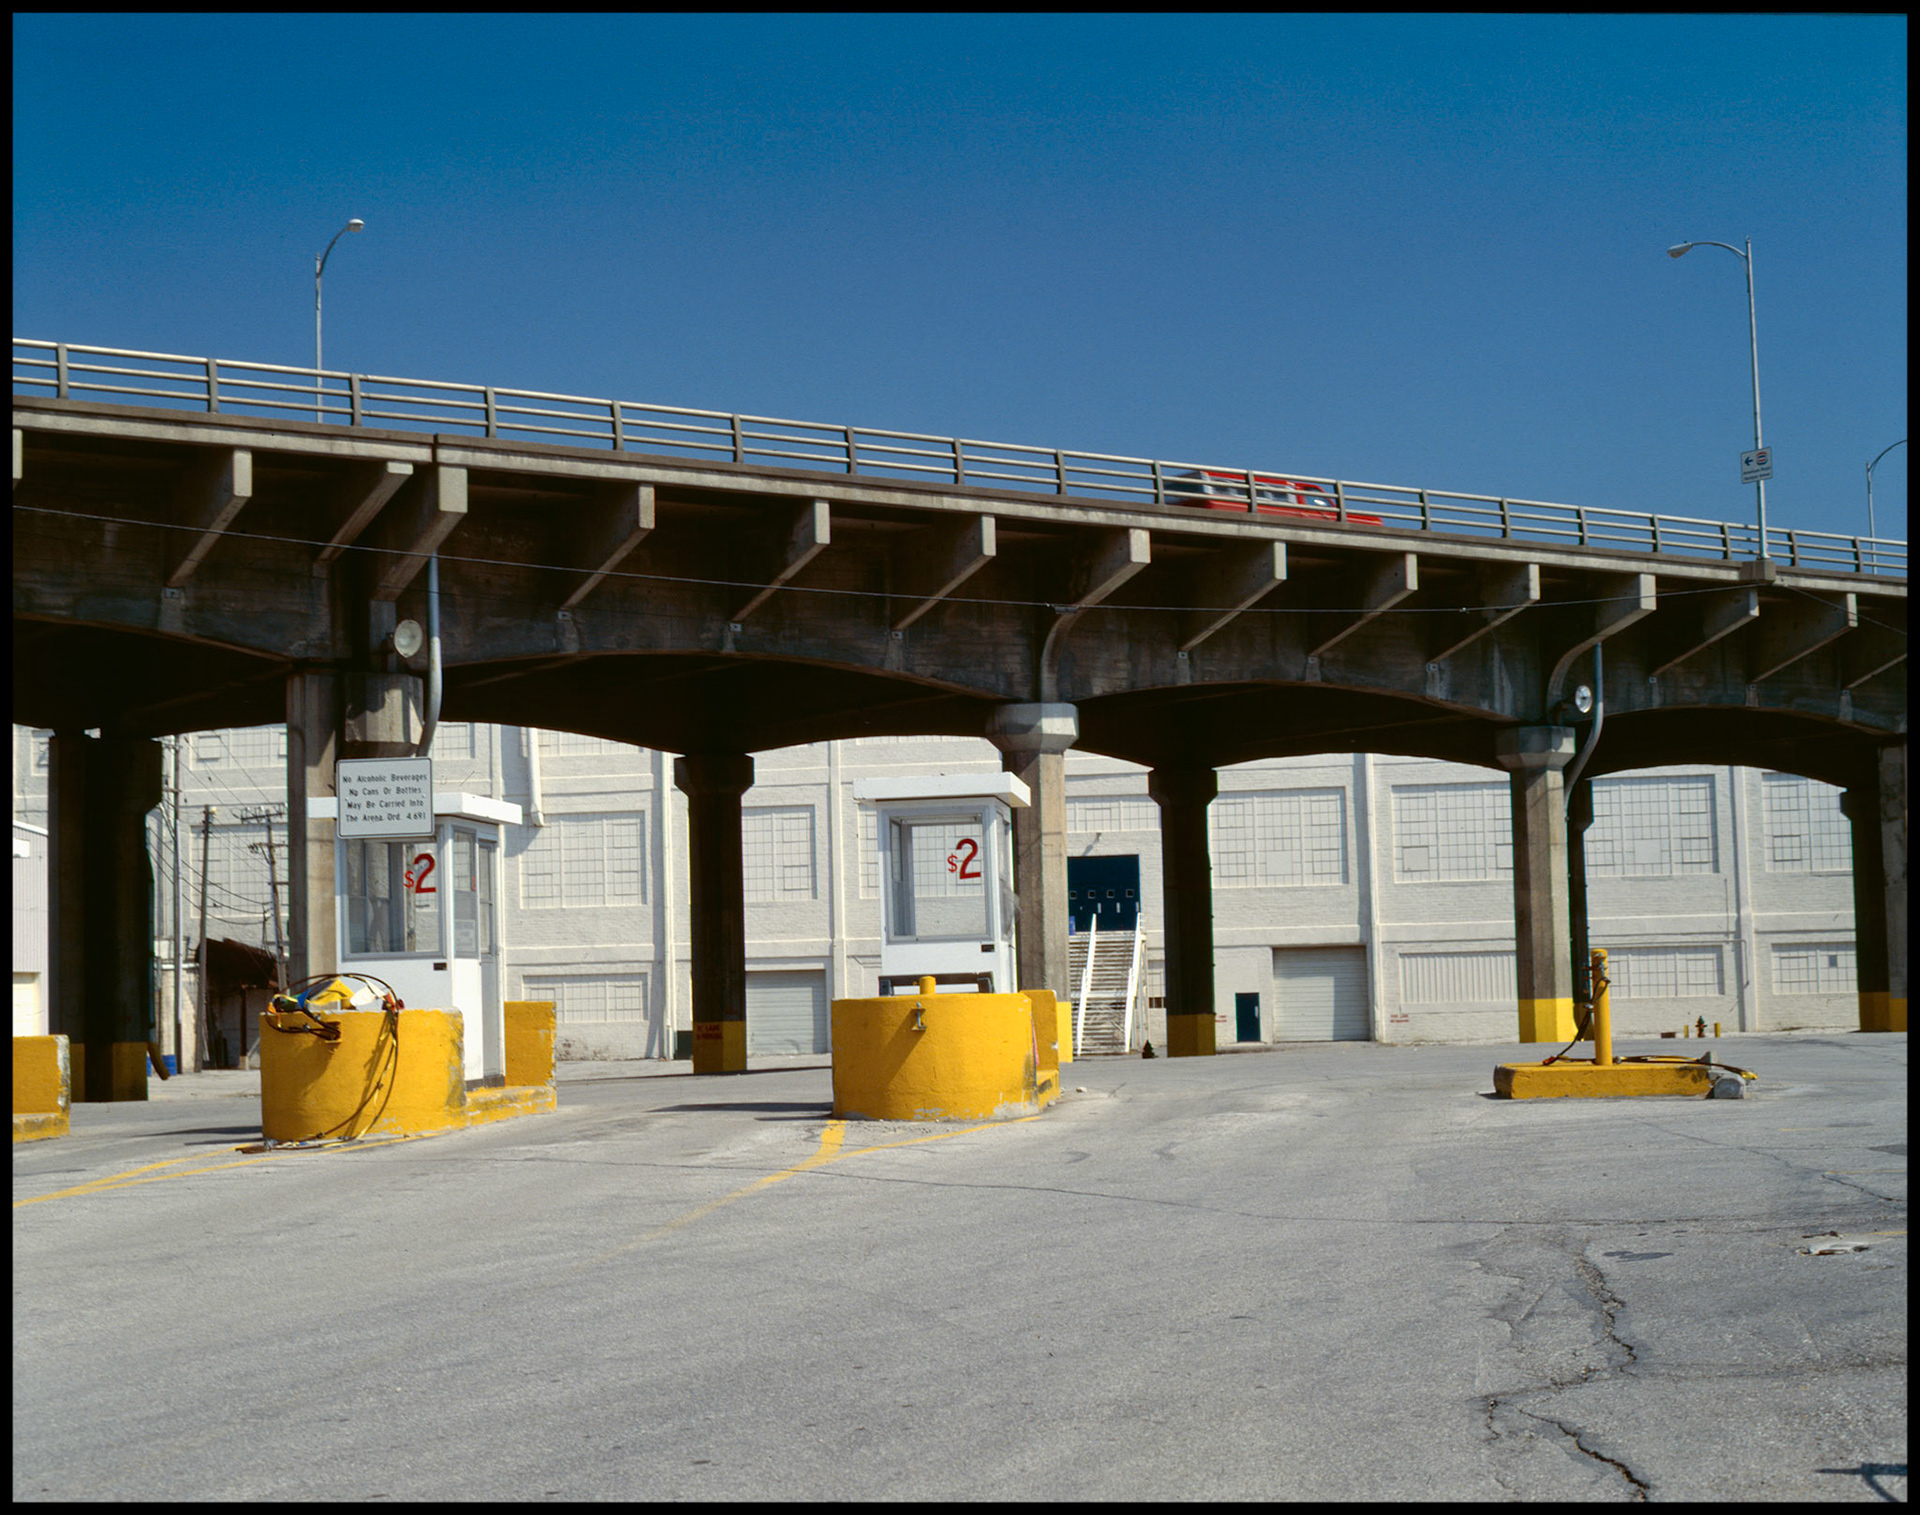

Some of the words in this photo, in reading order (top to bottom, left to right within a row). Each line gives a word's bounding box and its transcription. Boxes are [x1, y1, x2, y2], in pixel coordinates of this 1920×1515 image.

[357, 775, 387, 783] Alcoholic
[391, 773, 428, 782] Beverages
[349, 788, 359, 796] No
[362, 787, 380, 796] Cans
[383, 786, 392, 795] Or
[396, 786, 422, 794] Bottles
[347, 801, 361, 810] May
[366, 800, 376, 808] Be
[379, 800, 406, 808] Carried
[409, 799, 424, 807] Into
[346, 814, 358, 822] The
[947, 838, 981, 879] $2
[403, 853, 437, 893] $2
